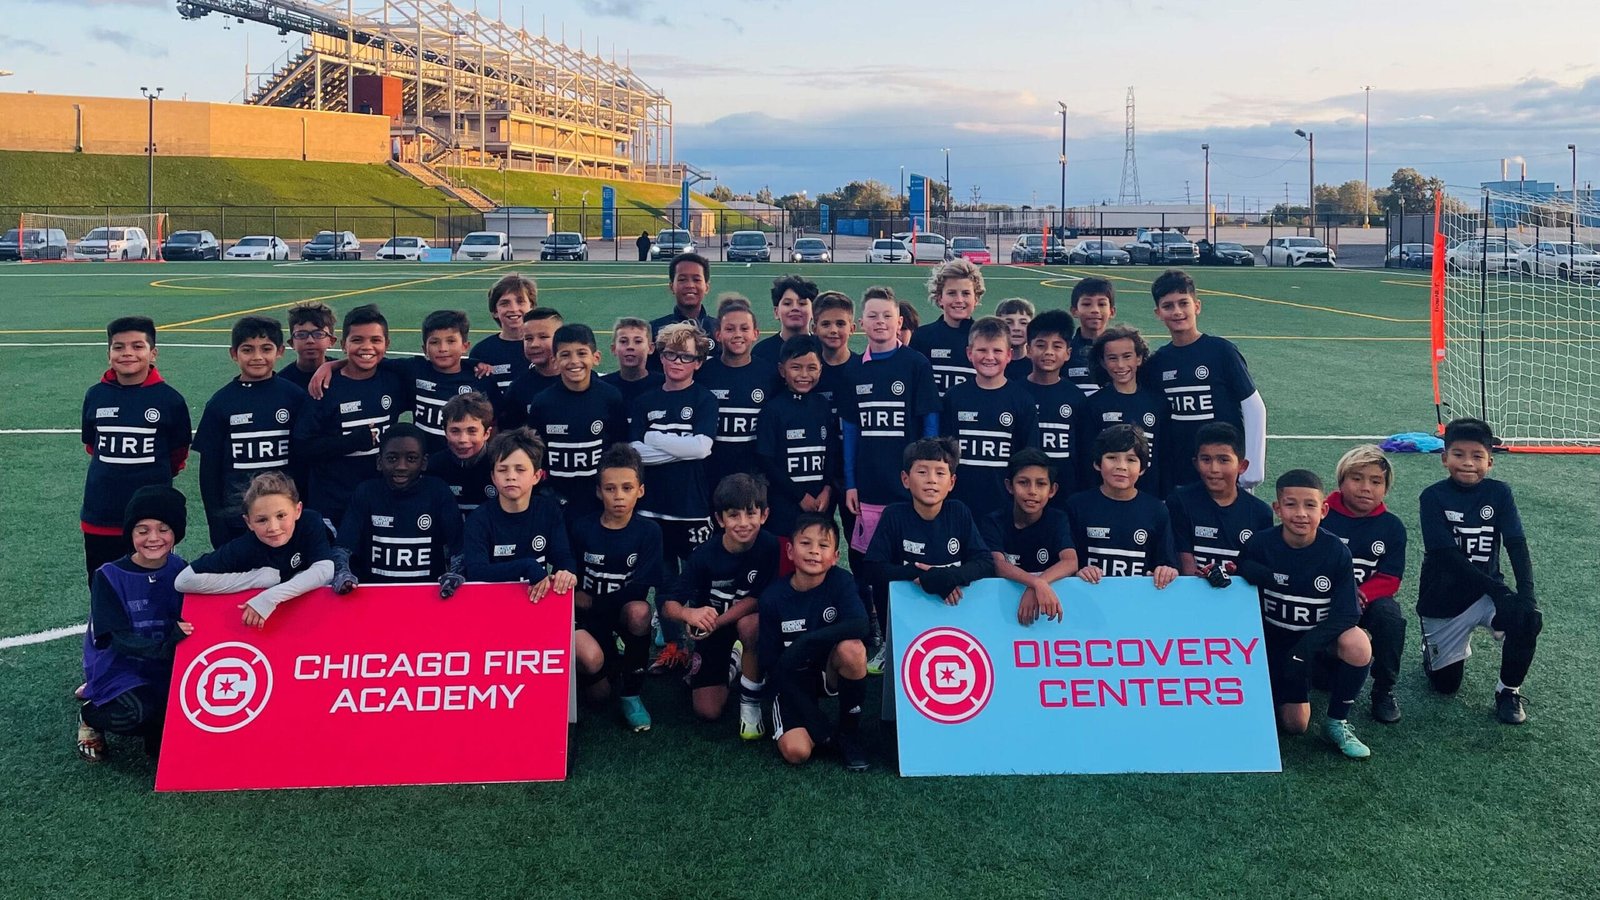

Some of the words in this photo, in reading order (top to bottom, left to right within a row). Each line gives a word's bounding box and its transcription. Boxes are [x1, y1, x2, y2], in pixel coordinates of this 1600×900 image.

[717, 417, 758, 432] IRE
[860, 411, 905, 427] FIRE
[98, 435, 155, 453] FIRE
[232, 439, 289, 459] FIRE
[959, 439, 1011, 458] FIRE
[548, 448, 602, 468] FIRE
[372, 545, 431, 566] FIRE
[1264, 598, 1330, 622] FIRE
[1013, 637, 1259, 669] DISCOVERY
[294, 652, 469, 680] CHICAGO
[484, 649, 565, 675] FIRE
[329, 684, 525, 714] ACADEMY
[1039, 677, 1244, 709] CENTERS
